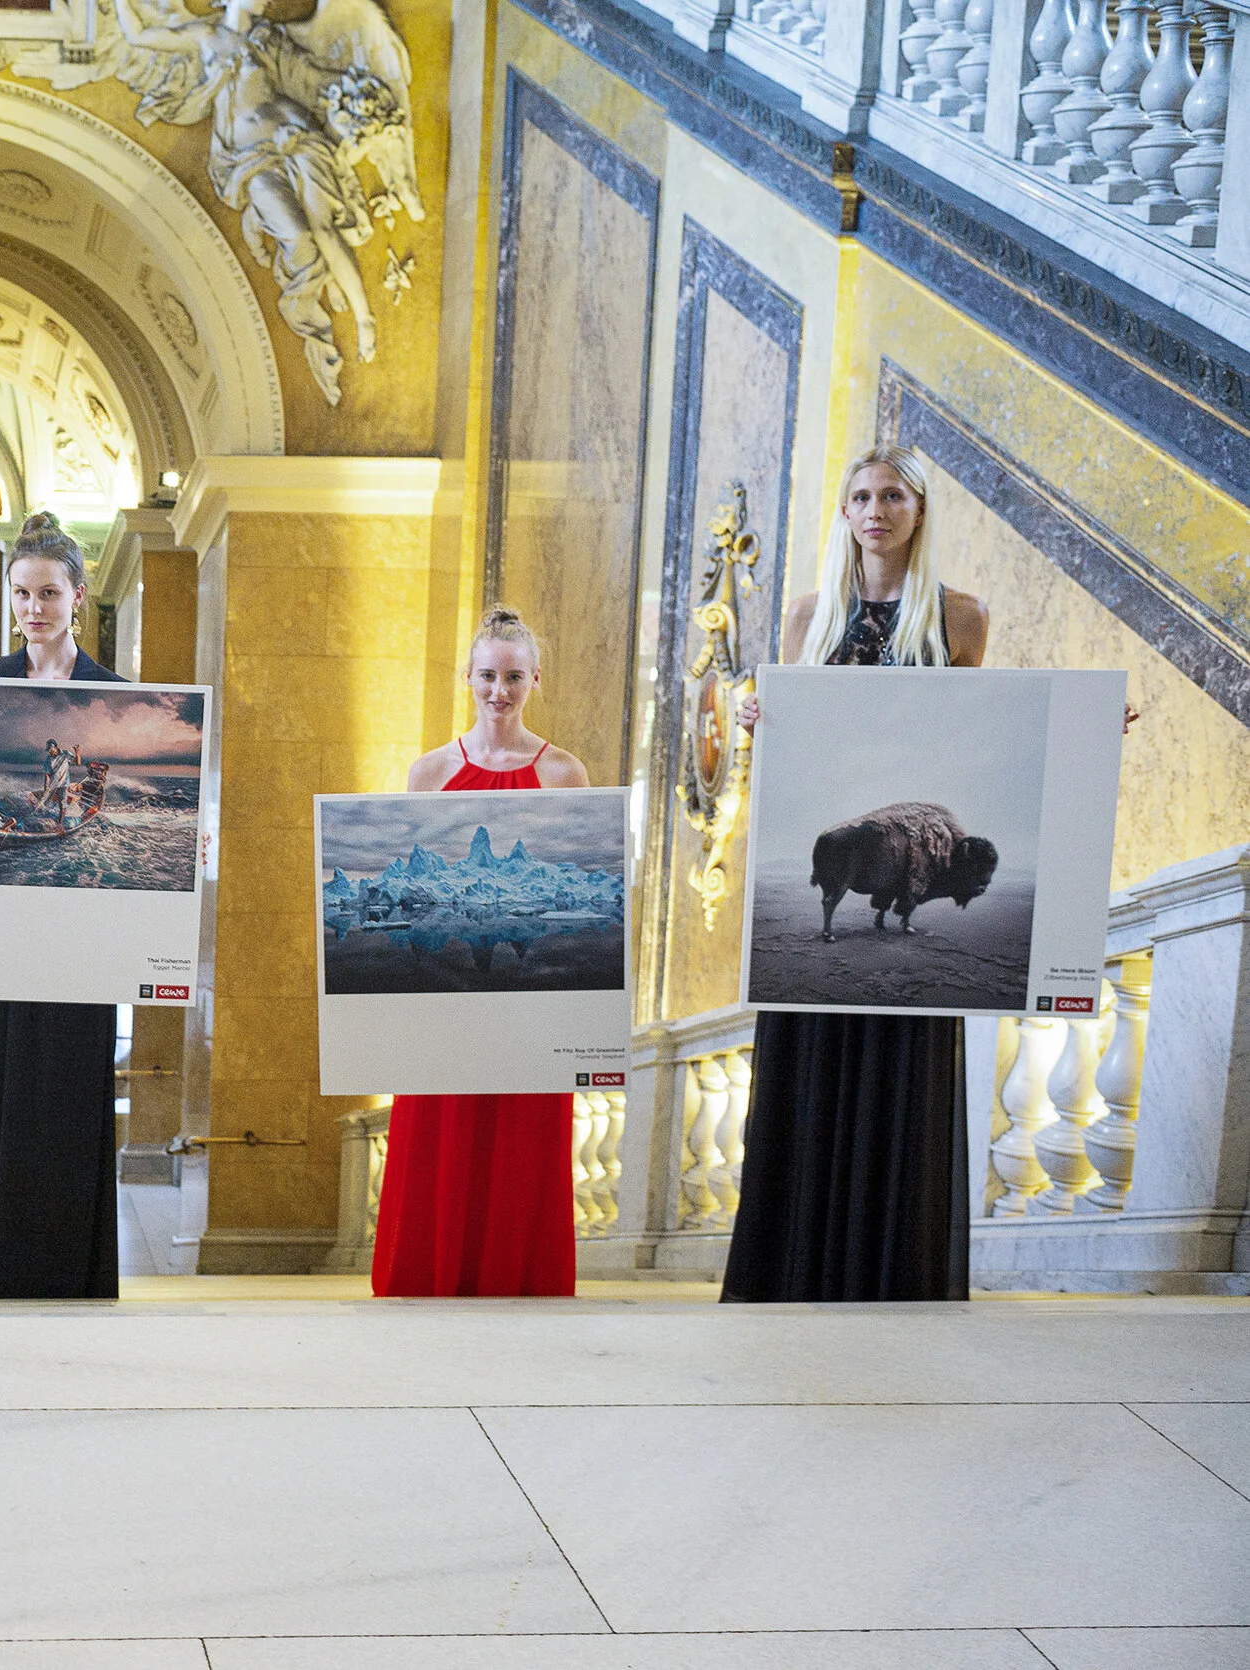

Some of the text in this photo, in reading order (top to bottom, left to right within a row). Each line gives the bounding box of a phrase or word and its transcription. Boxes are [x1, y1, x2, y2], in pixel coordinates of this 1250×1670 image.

[158, 988, 186, 997] cewe
[1058, 1000, 1089, 1009] cewe
[595, 1075, 622, 1084] cewe
